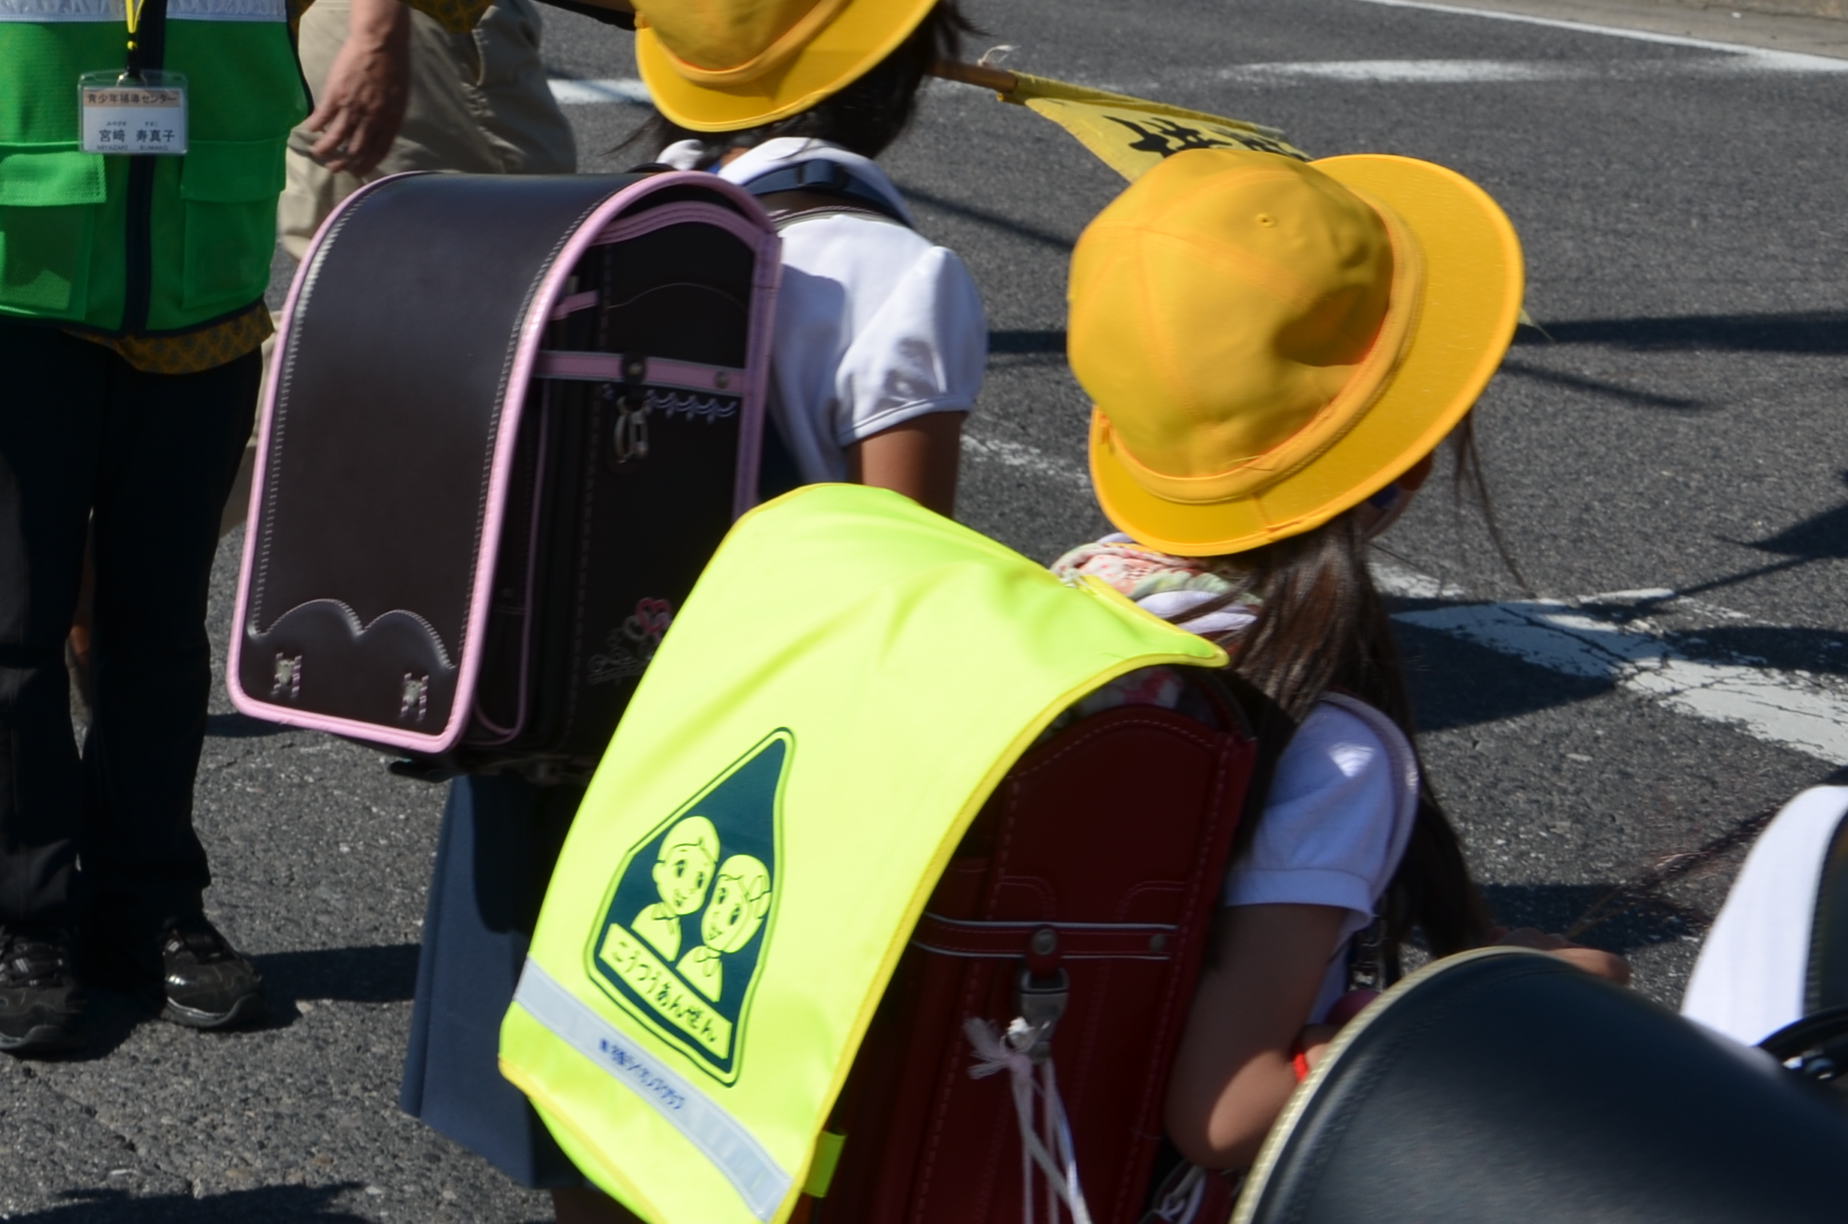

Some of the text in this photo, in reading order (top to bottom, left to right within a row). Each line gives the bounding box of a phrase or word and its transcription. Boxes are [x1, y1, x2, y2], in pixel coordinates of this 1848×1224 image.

[87, 93, 177, 105] 青少年補導センター
[611, 940, 719, 1043] こうつうあんぜん
